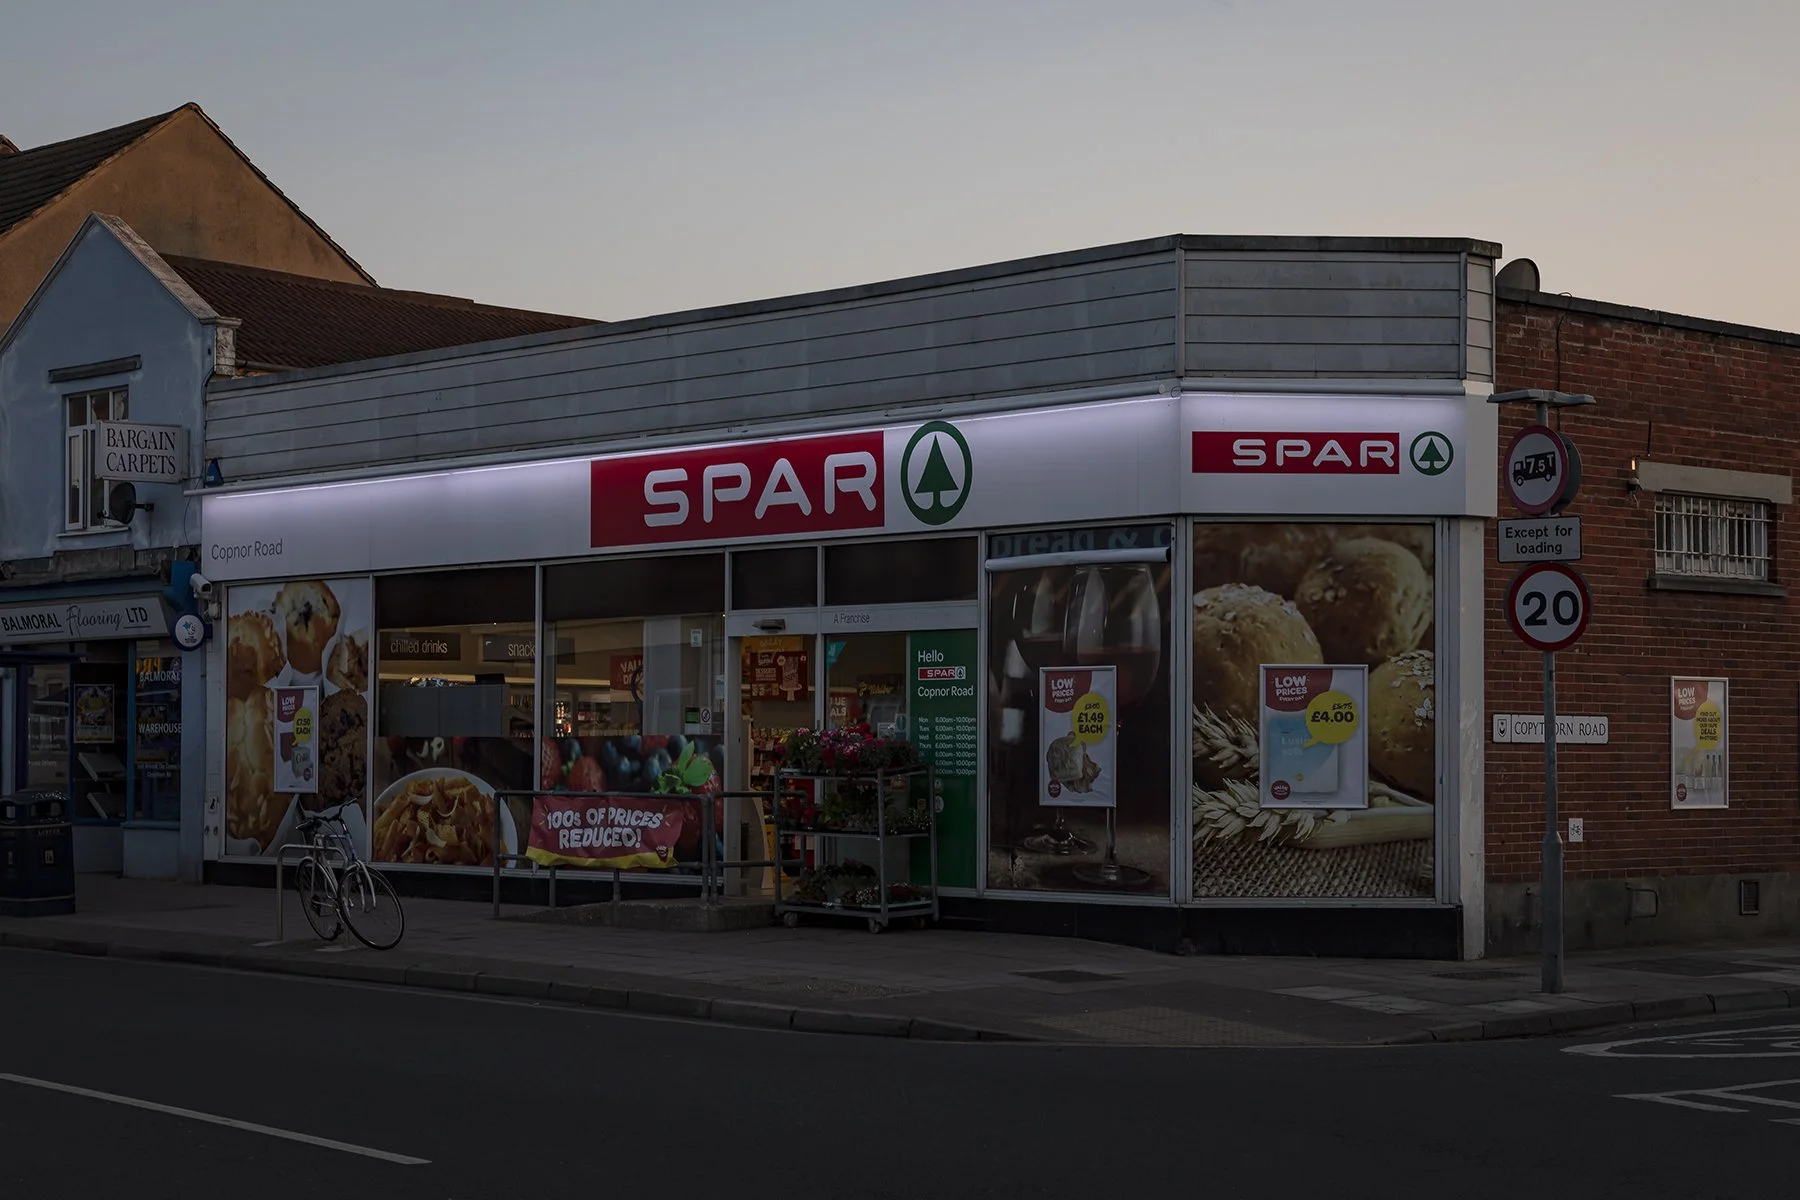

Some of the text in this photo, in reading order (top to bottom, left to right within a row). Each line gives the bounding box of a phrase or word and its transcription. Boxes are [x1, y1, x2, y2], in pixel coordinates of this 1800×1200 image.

[106, 428, 176, 451] BARGAIN
[1232, 438, 1395, 468] SPAR
[106, 452, 176, 475] CARPETS
[643, 450, 878, 528] SPAR
[1505, 525, 1573, 541] Except for
[211, 537, 283, 564] Copnor Road
[1516, 542, 1562, 555] loading
[1522, 590, 1580, 626] 20
[0, 604, 148, 638] BALMORAL Flooring LTD
[833, 612, 871, 624] A Franchise
[390, 639, 448, 654] chilled drinks
[917, 649, 945, 662] Hello
[139, 669, 181, 682] BALMORAL
[927, 669, 956, 678] SPAR
[1051, 677, 1074, 690] LOW
[1274, 675, 1307, 688] LOW
[917, 686, 951, 700] Copnor
[951, 685, 974, 697] Road
[1052, 688, 1075, 699] PRICES
[1275, 686, 1308, 696] PRICES
[1677, 686, 1695, 698] LOW
[1077, 712, 1105, 723] £1.49
[1310, 710, 1354, 723] £4.00
[138, 722, 182, 735] WAREHOUSE
[1078, 724, 1103, 734] EACH
[1515, 720, 1607, 737] COPYTRN ROAD
[585, 807, 606, 826] OF
[607, 806, 664, 829] PRICES
[559, 827, 642, 850] REDUCED!
